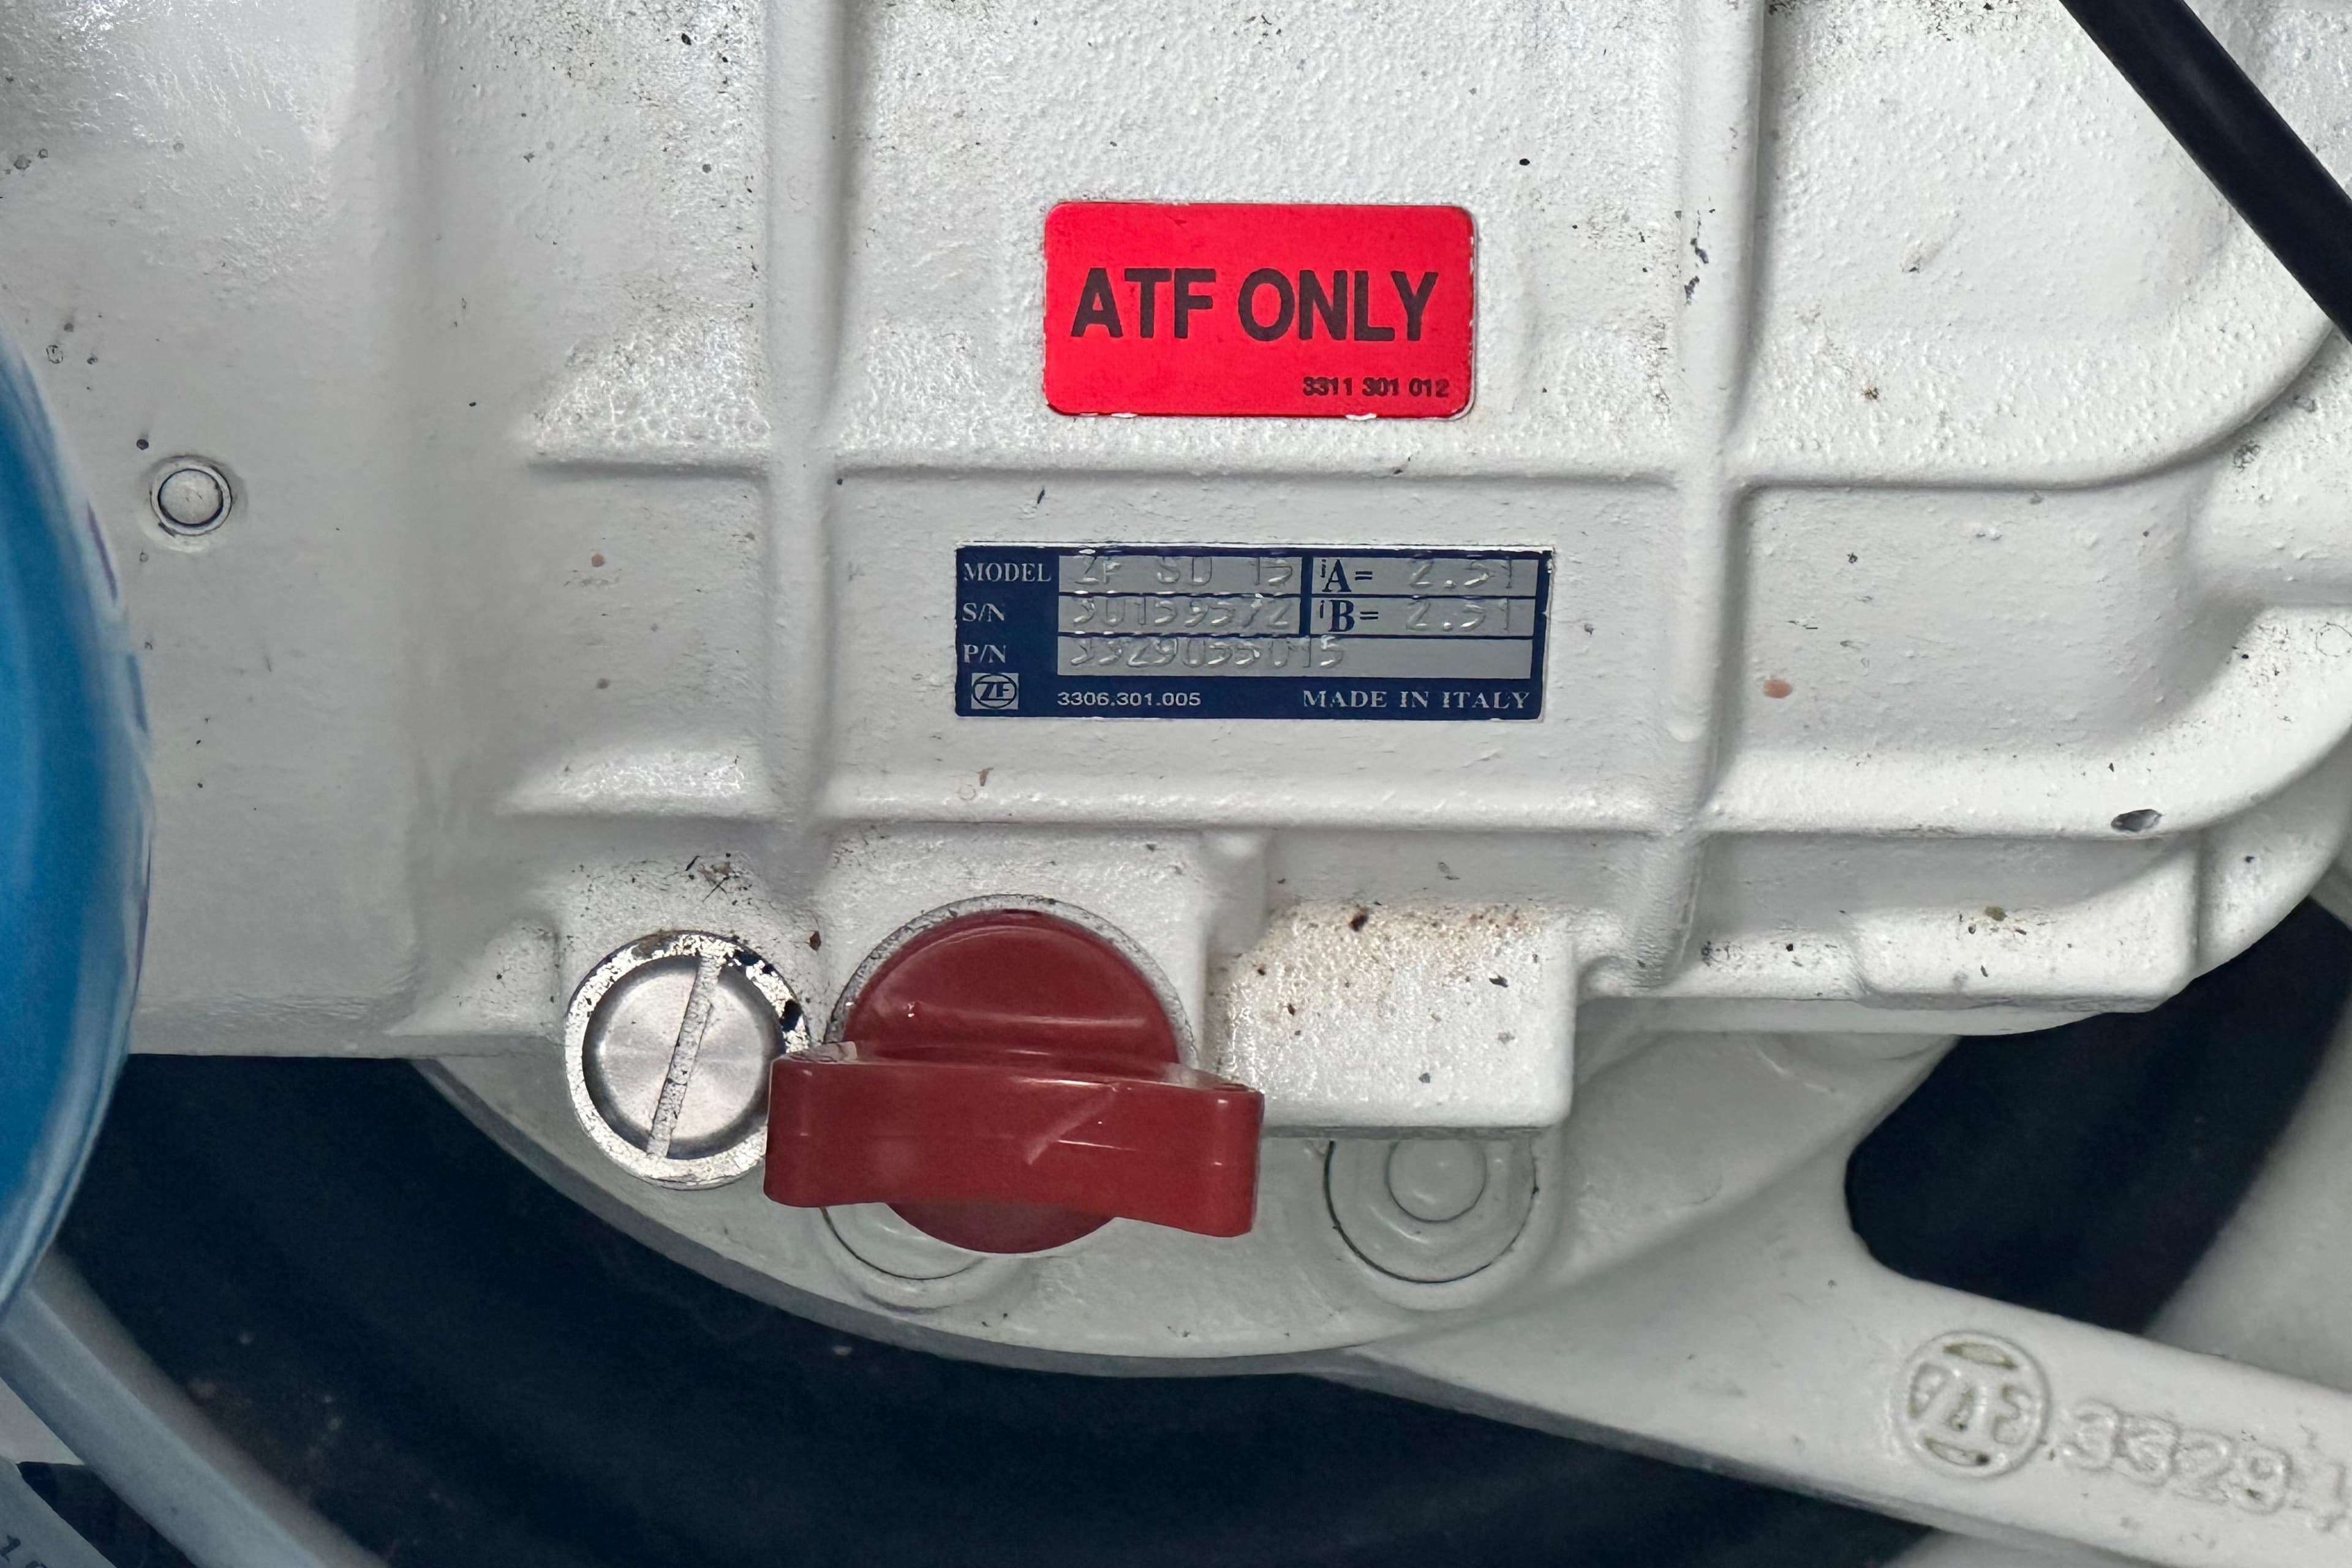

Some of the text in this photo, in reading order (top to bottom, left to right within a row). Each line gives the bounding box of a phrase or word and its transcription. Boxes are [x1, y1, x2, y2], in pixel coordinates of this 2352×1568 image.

[1071, 266, 1439, 342] ATF ONLY
[1302, 376, 1450, 399] 3311 301 012
[963, 562, 1052, 582] MODEL
[1409, 556, 1513, 589] 2.51
[962, 602, 1005, 622] S/N
[1406, 598, 1510, 631] 2.51
[963, 644, 1006, 664] P/N
[978, 679, 1017, 703] ZF
[1057, 692, 1201, 707] 3306.301.005
[1303, 690, 1531, 709] MADE IN ITALY
[1906, 1340, 2045, 1470] ZF
